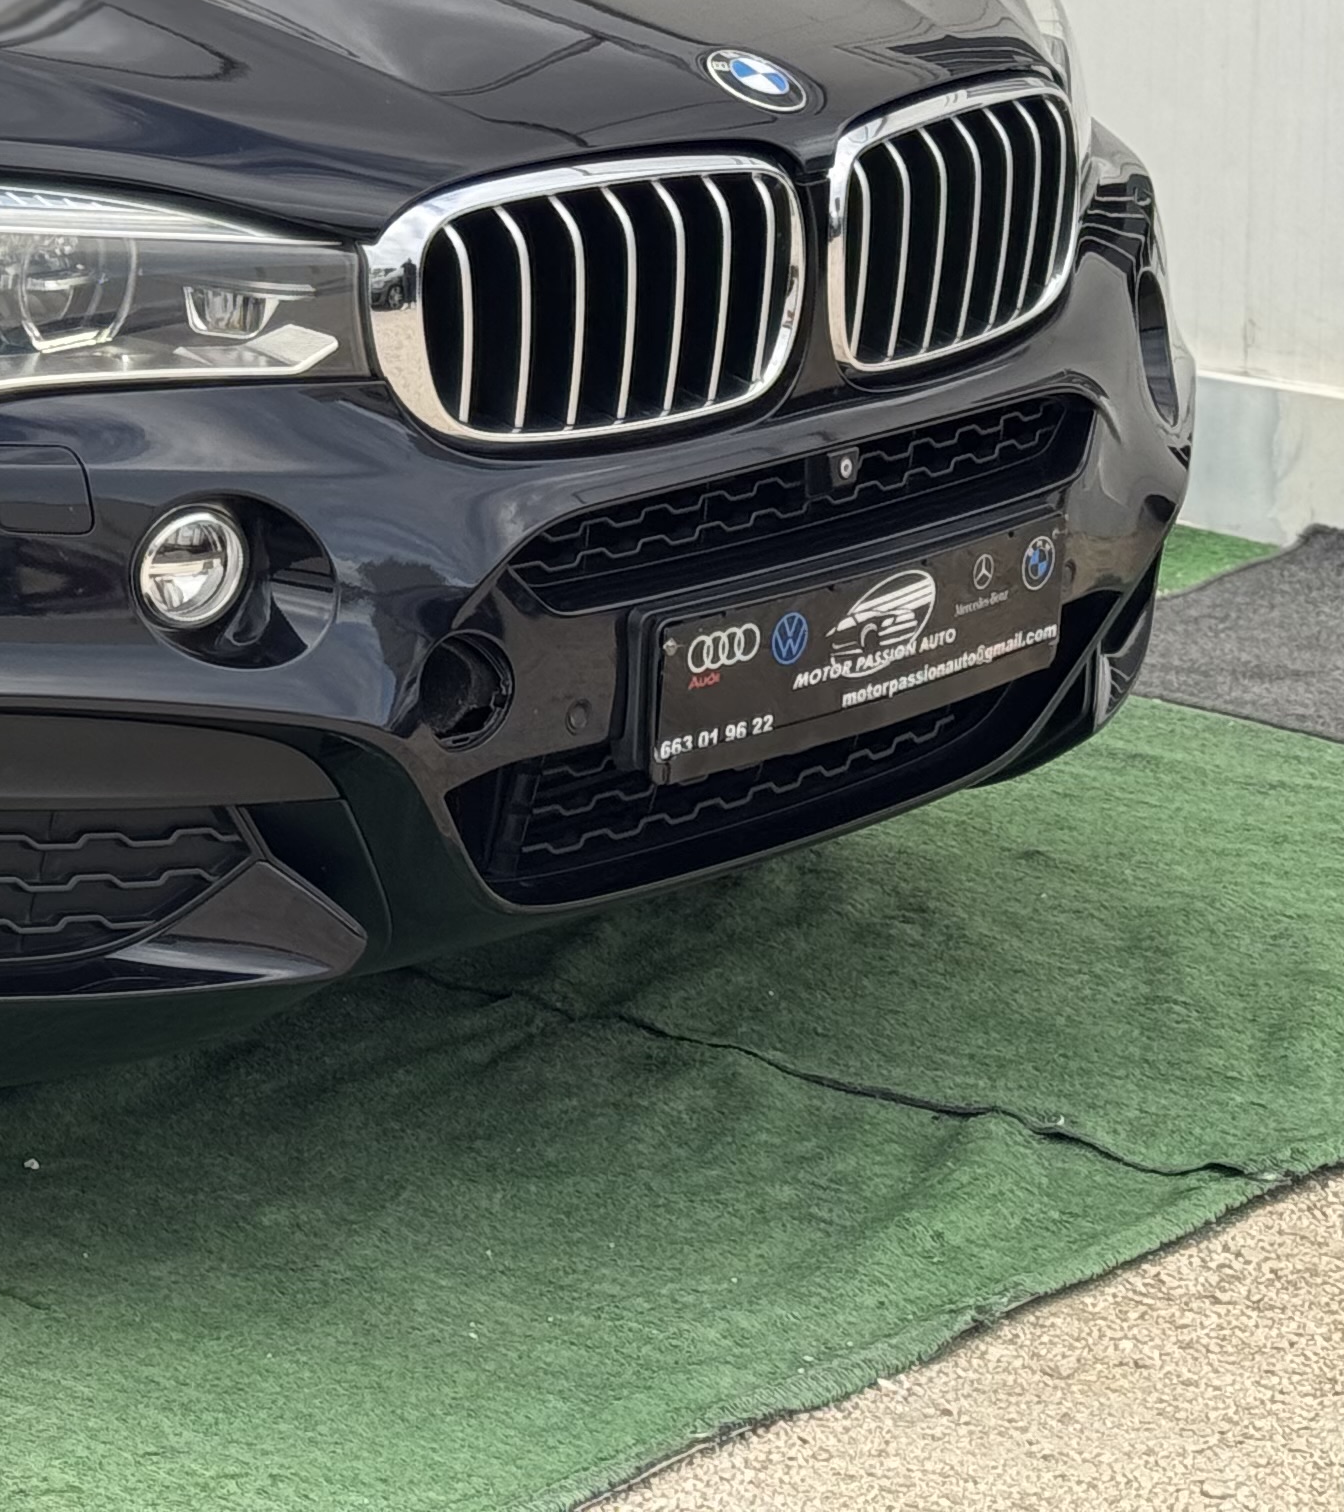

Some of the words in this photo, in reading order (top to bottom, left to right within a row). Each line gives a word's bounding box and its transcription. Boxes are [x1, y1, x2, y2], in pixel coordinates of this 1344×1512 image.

[793, 659, 853, 690] MOTOR
[855, 641, 918, 672] PASSION
[919, 628, 957, 653] AUTO
[842, 624, 1058, 708] motorpassionauto@gmail.com
[660, 735, 693, 760] 663
[698, 728, 719, 749] 01
[724, 721, 747, 742] 96
[751, 714, 774, 735] 22
